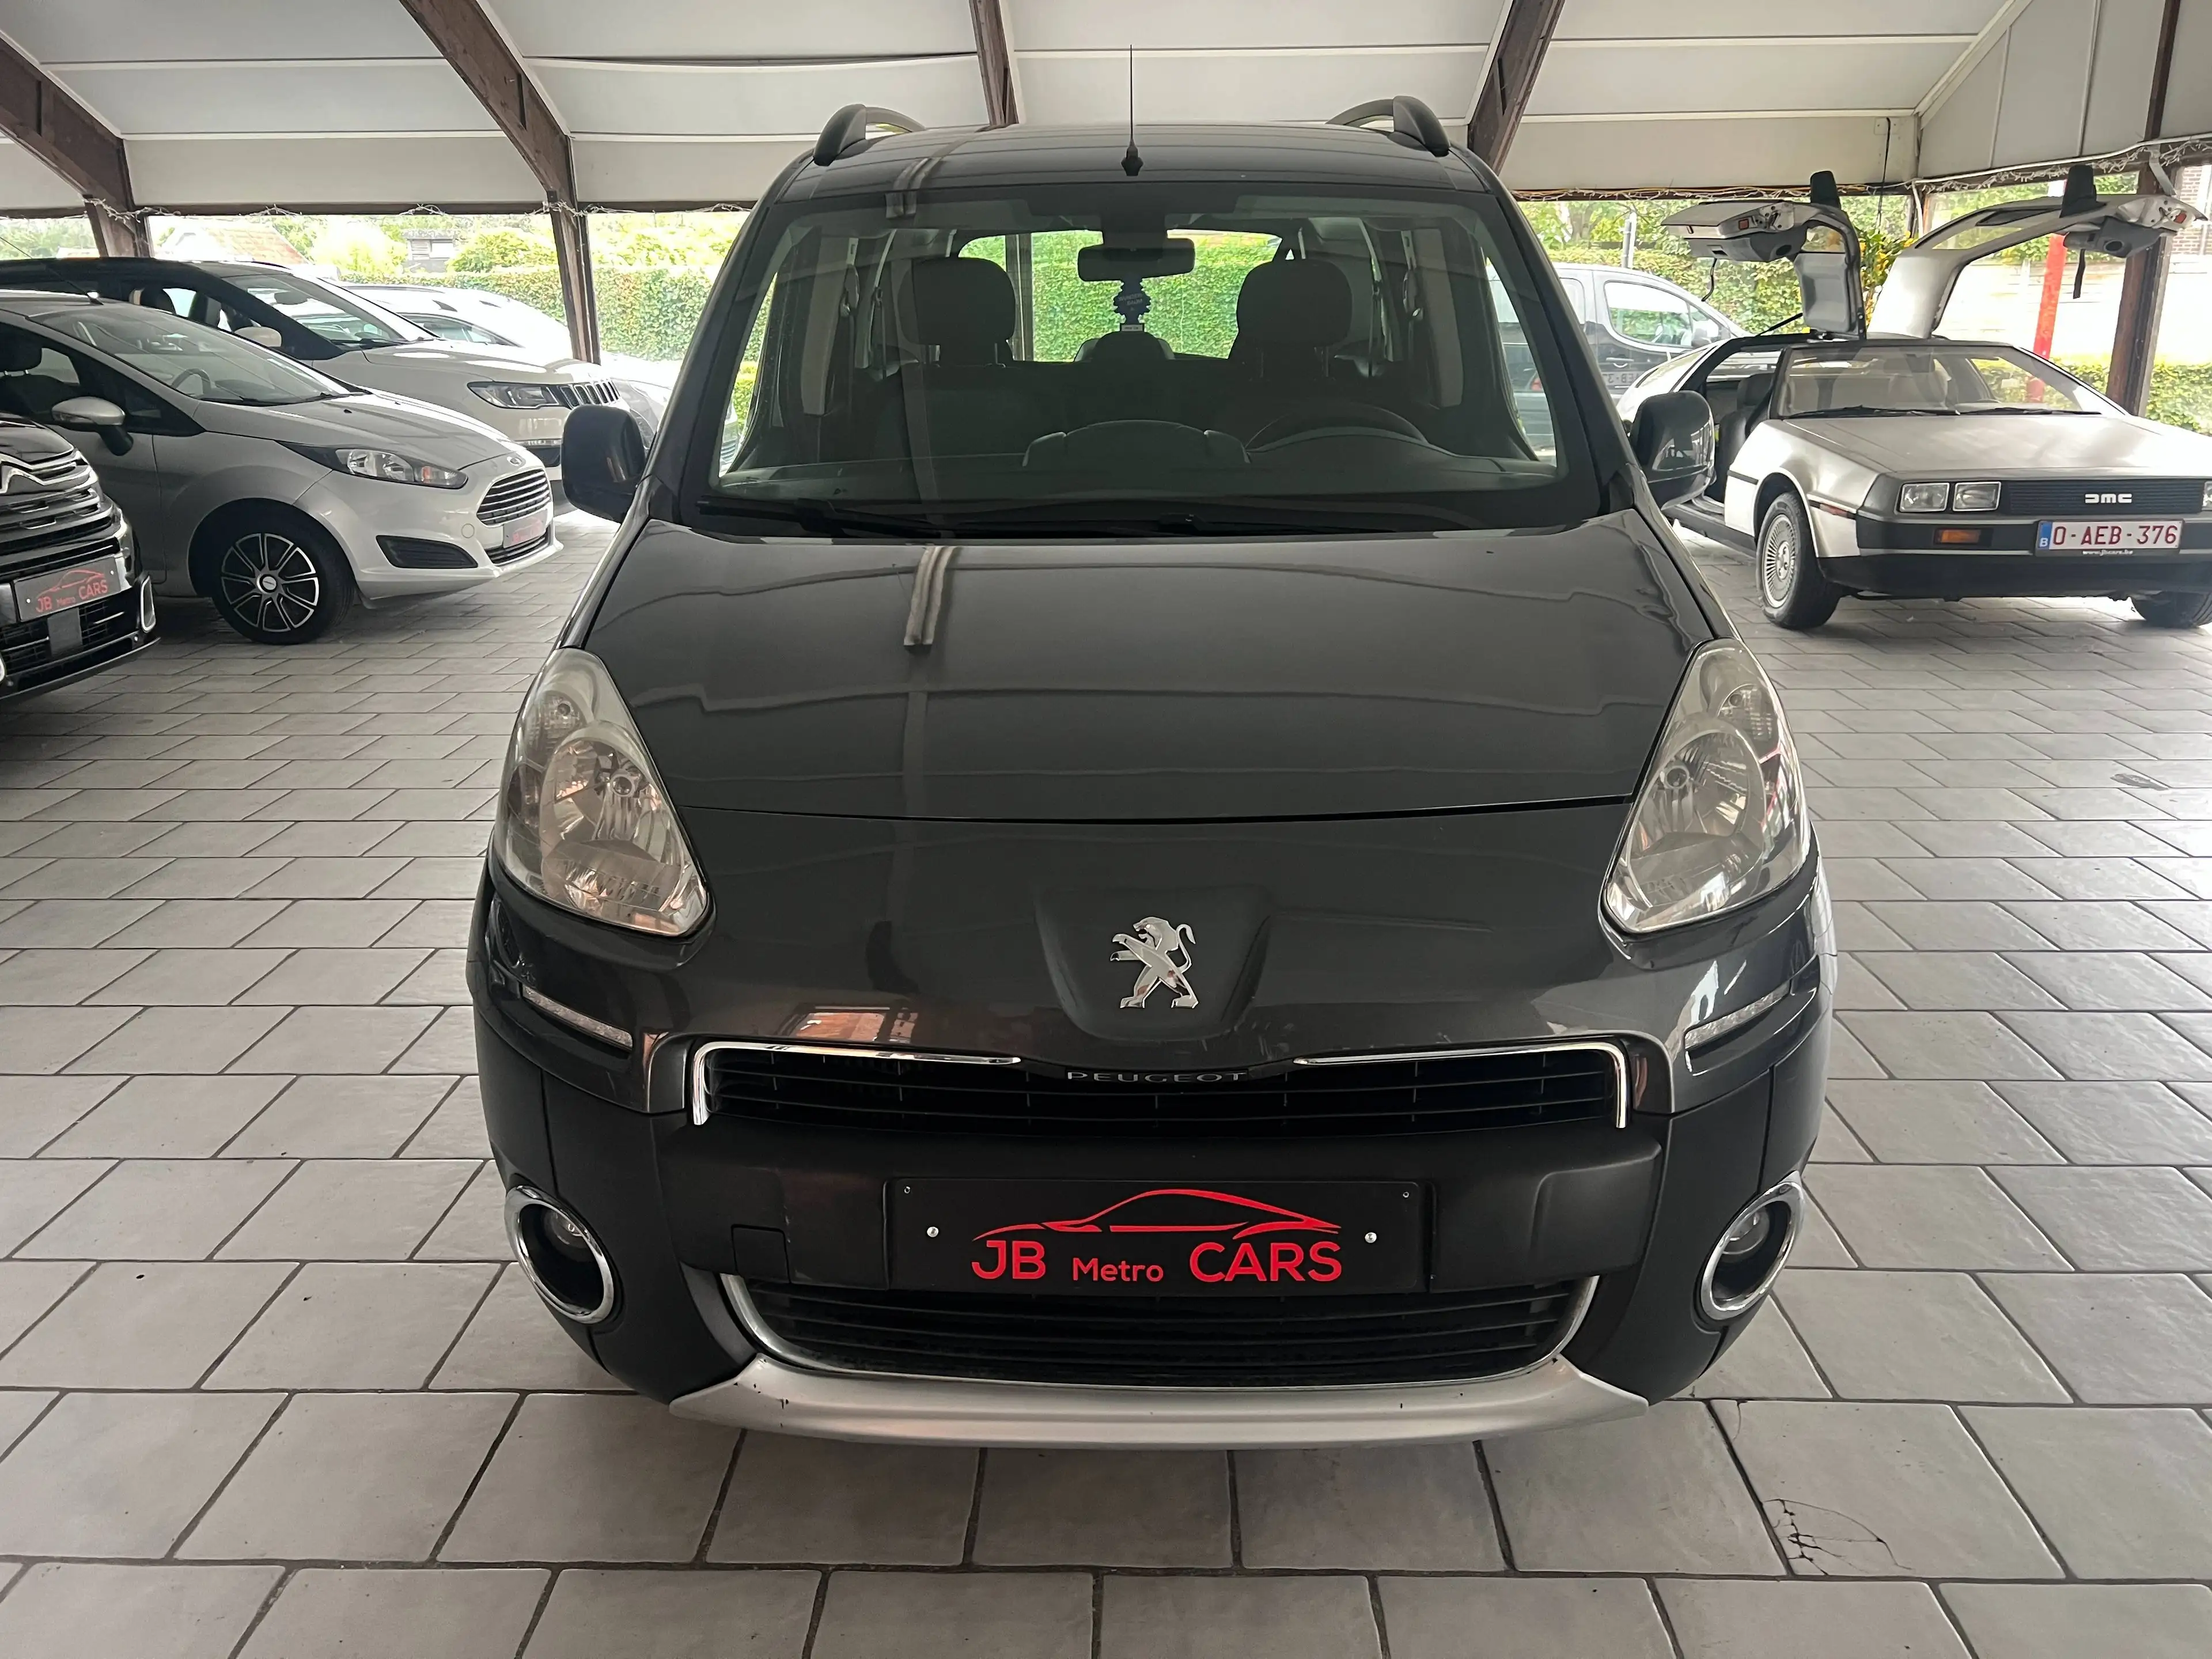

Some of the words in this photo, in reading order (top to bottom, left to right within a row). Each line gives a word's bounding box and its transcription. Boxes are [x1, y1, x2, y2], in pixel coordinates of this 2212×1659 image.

[2040, 537, 2048, 547] B
[36, 596, 52, 612] JB
[78, 579, 108, 600] CARS
[1067, 1071, 1247, 1082] PEUGEOT
[971, 1239, 1047, 1280] JB
[1072, 1257, 1164, 1282] Metro
[1189, 1240, 1342, 1283] CARS
